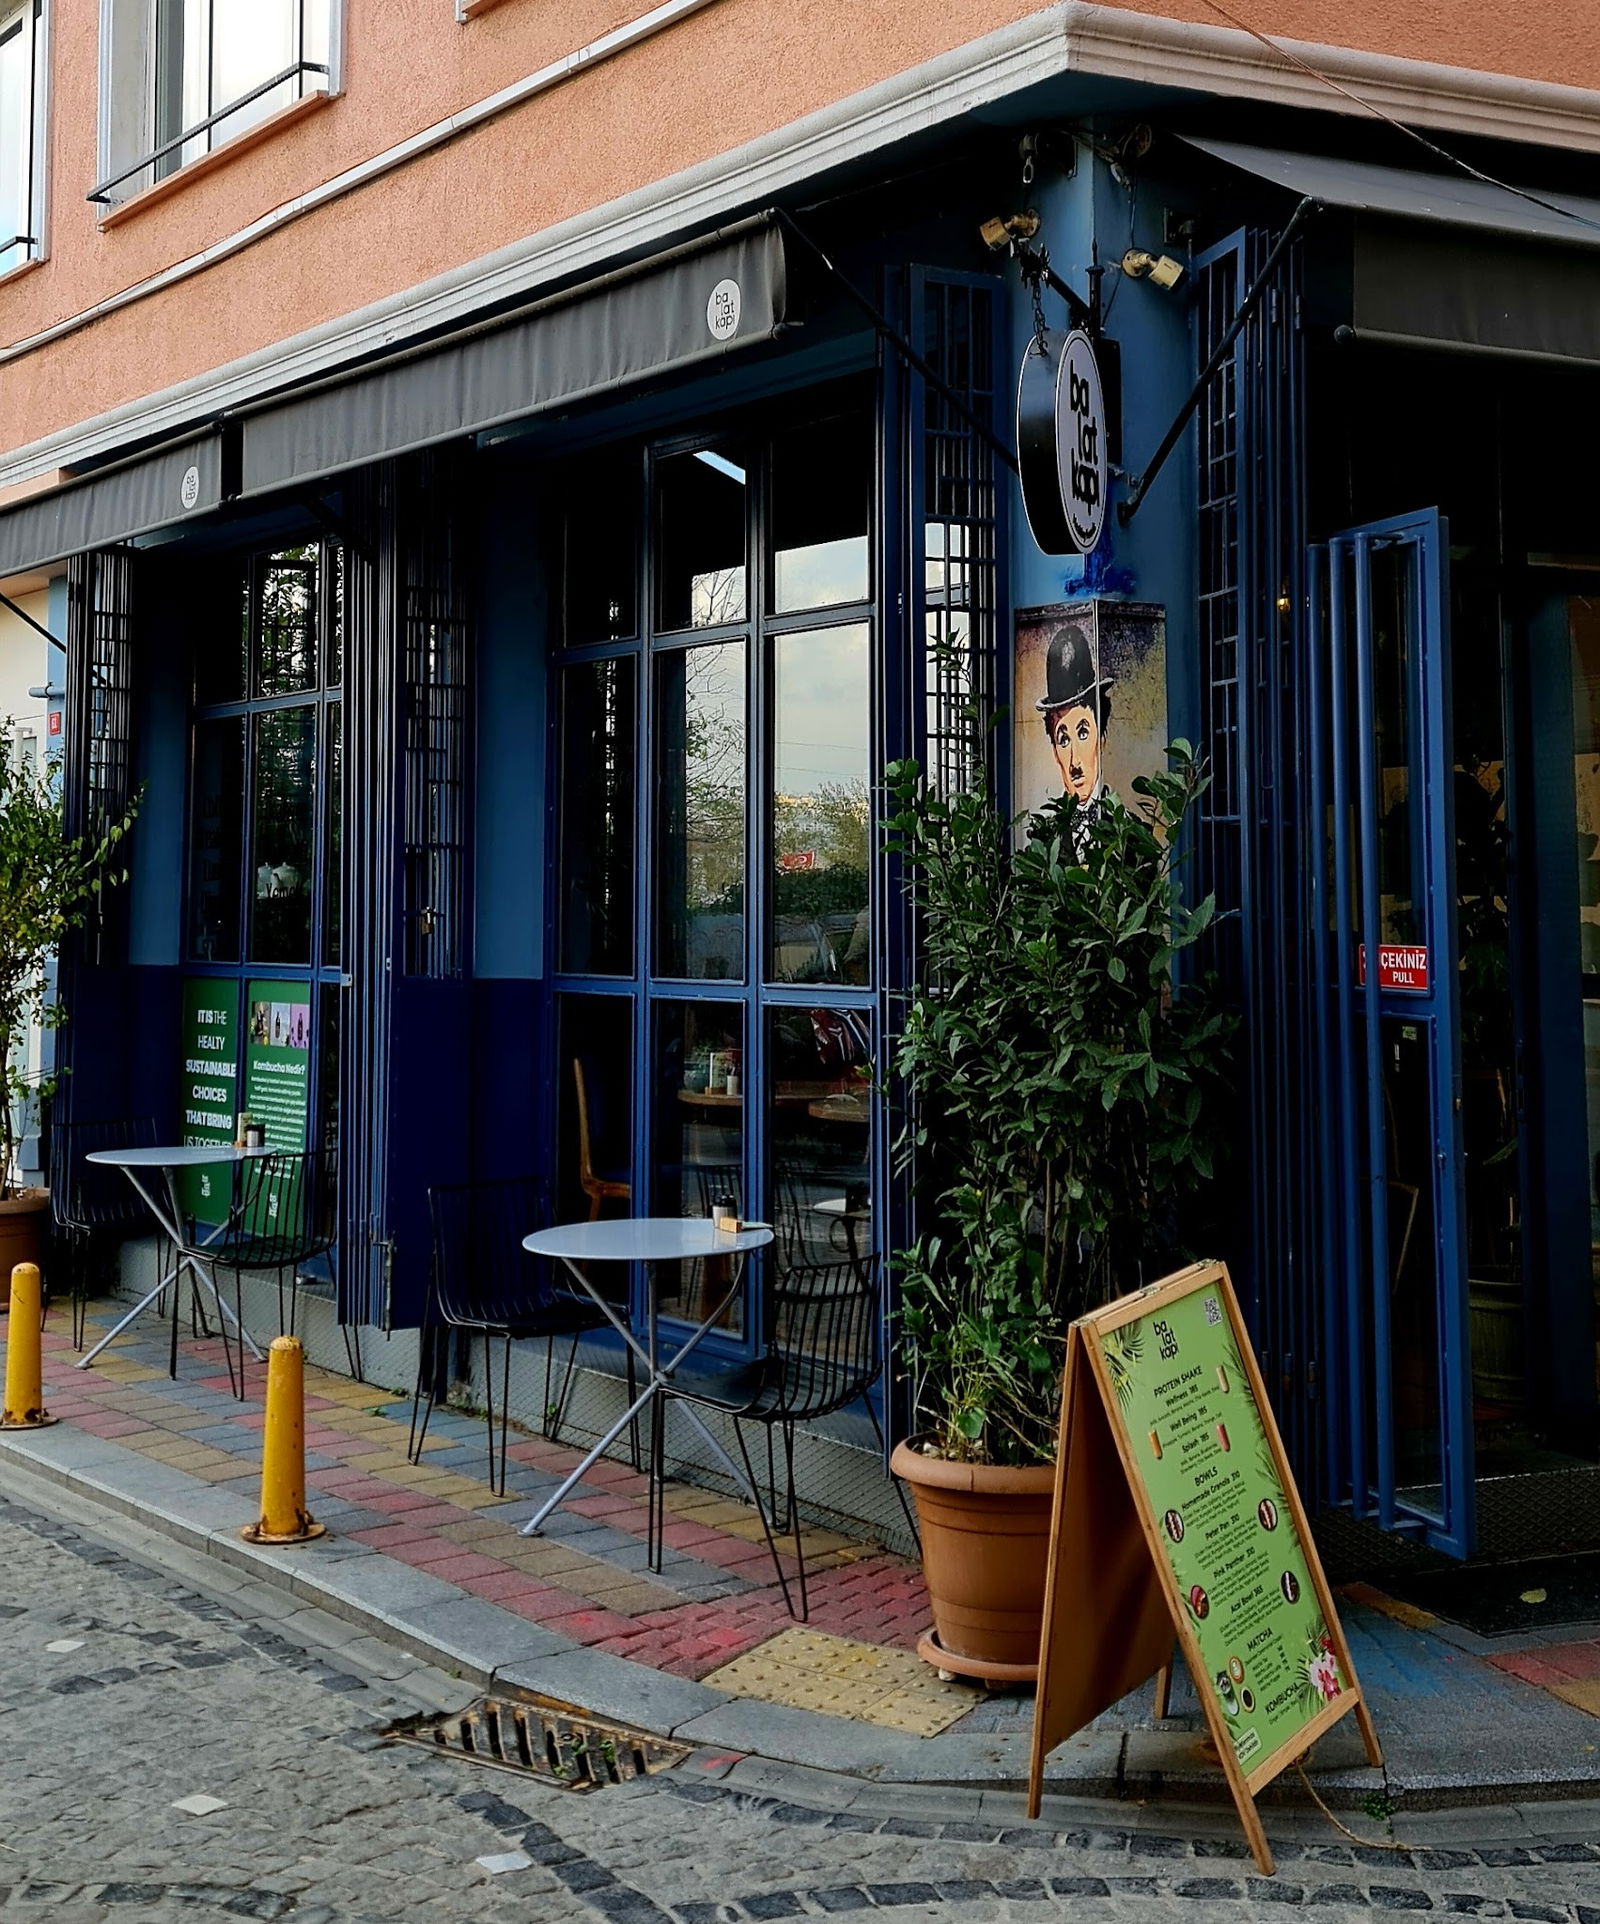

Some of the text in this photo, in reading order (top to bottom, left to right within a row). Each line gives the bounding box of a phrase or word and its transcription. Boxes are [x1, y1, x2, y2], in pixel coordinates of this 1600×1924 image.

[716, 292, 728, 305] ba
[721, 300, 734, 316] lat
[1070, 360, 1090, 418] ba
[1078, 412, 1098, 466] lat
[1380, 948, 1427, 970] ÇEKİNİZ
[1392, 971, 1415, 984] PULL
[197, 1009, 228, 1025] IT IS THE
[197, 1034, 225, 1051] HEALTY
[186, 1059, 237, 1078] SUSTAINABLE
[192, 1085, 227, 1103] CHOICES
[185, 1110, 233, 1130] THAT BRING
[1153, 1321, 1167, 1335] ba
[1162, 1328, 1176, 1346] lat
[1153, 1365, 1202, 1397] PROTEIN SHAKE
[1194, 1466, 1217, 1486] BOWLS
[1181, 1489, 1210, 1509] Homemade
[1204, 1527, 1218, 1539] Peter
[1219, 1521, 1229, 1531] Pan
[1246, 1627, 1272, 1651] MATCHA
[1264, 1682, 1299, 1714] KOMBUCHA
